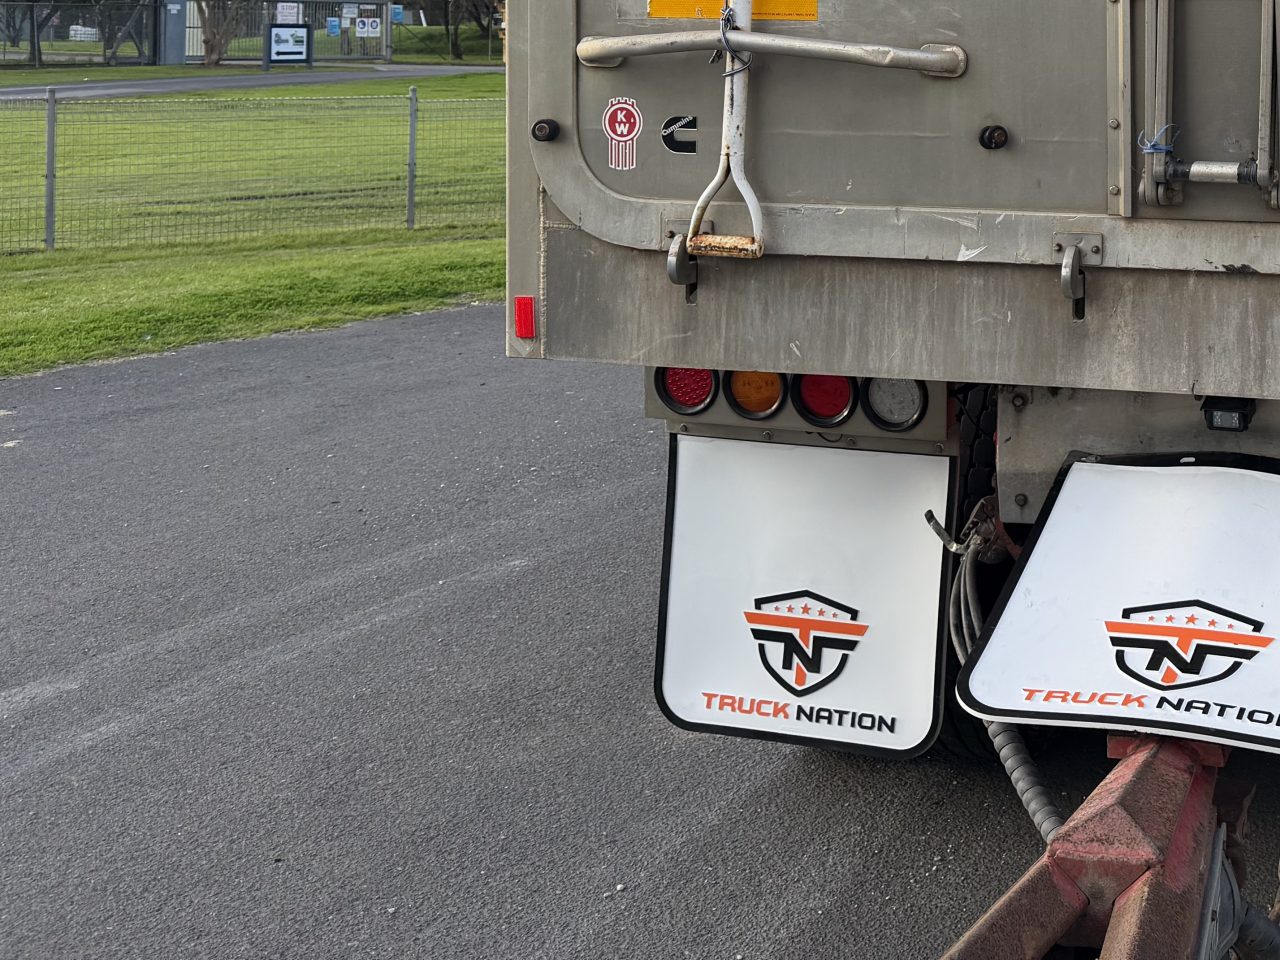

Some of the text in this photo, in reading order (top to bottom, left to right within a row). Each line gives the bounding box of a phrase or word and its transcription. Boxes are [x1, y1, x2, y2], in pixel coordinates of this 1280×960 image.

[702, 692, 896, 733] TRUCK NATION
[1022, 688, 1148, 708] TRUCK
